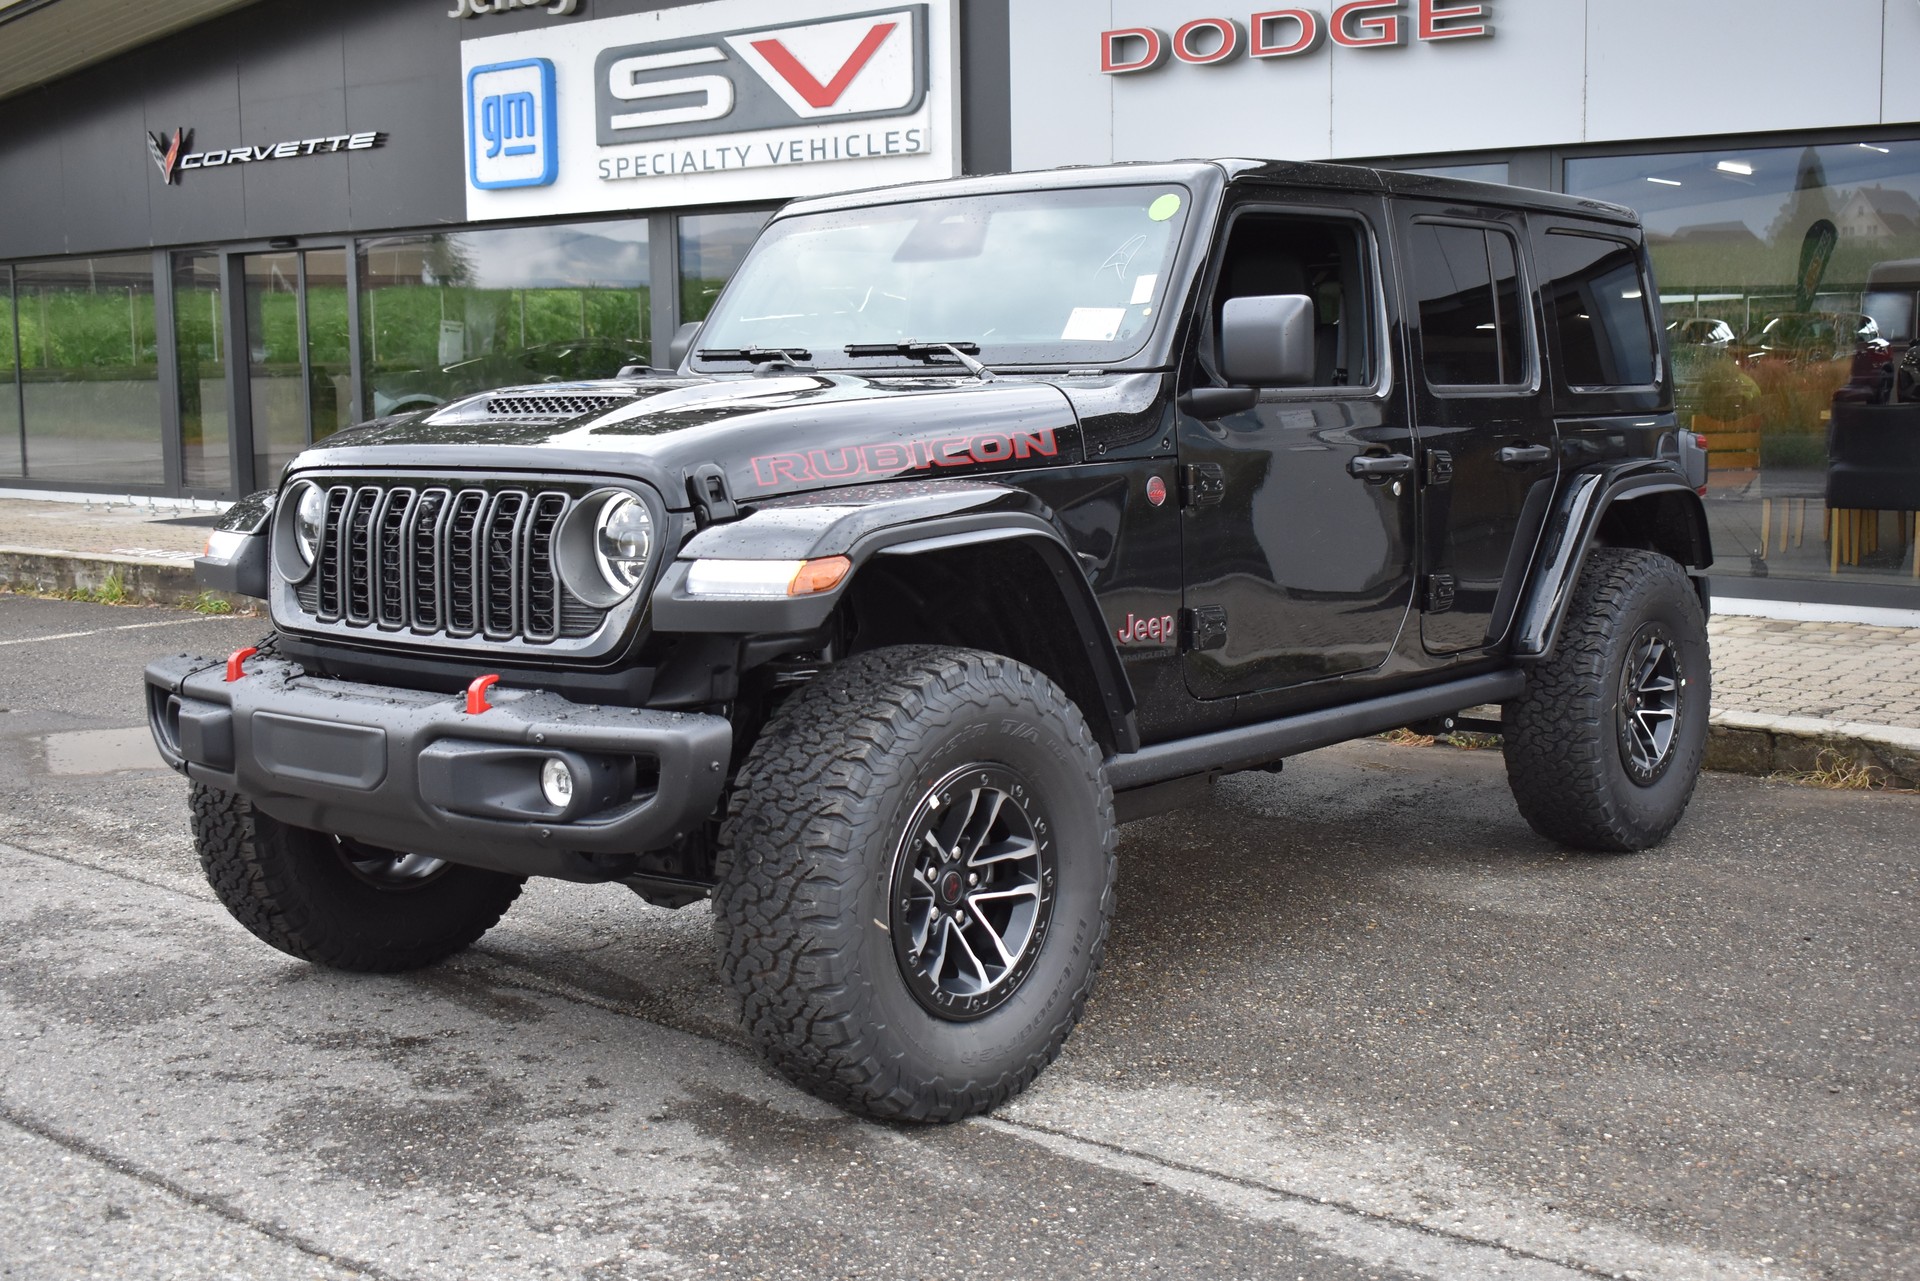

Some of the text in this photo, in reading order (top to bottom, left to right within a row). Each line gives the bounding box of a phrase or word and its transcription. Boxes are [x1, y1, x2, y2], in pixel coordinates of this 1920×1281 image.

[1101, 0, 1490, 74] DODGE
[608, 21, 901, 130] SV
[180, 131, 378, 170] CORVETTE
[481, 91, 536, 158] gm
[598, 129, 922, 180] SPECIALTY VEHICLES
[751, 428, 1058, 487] RUBICON
[1118, 613, 1175, 644] Jeep
